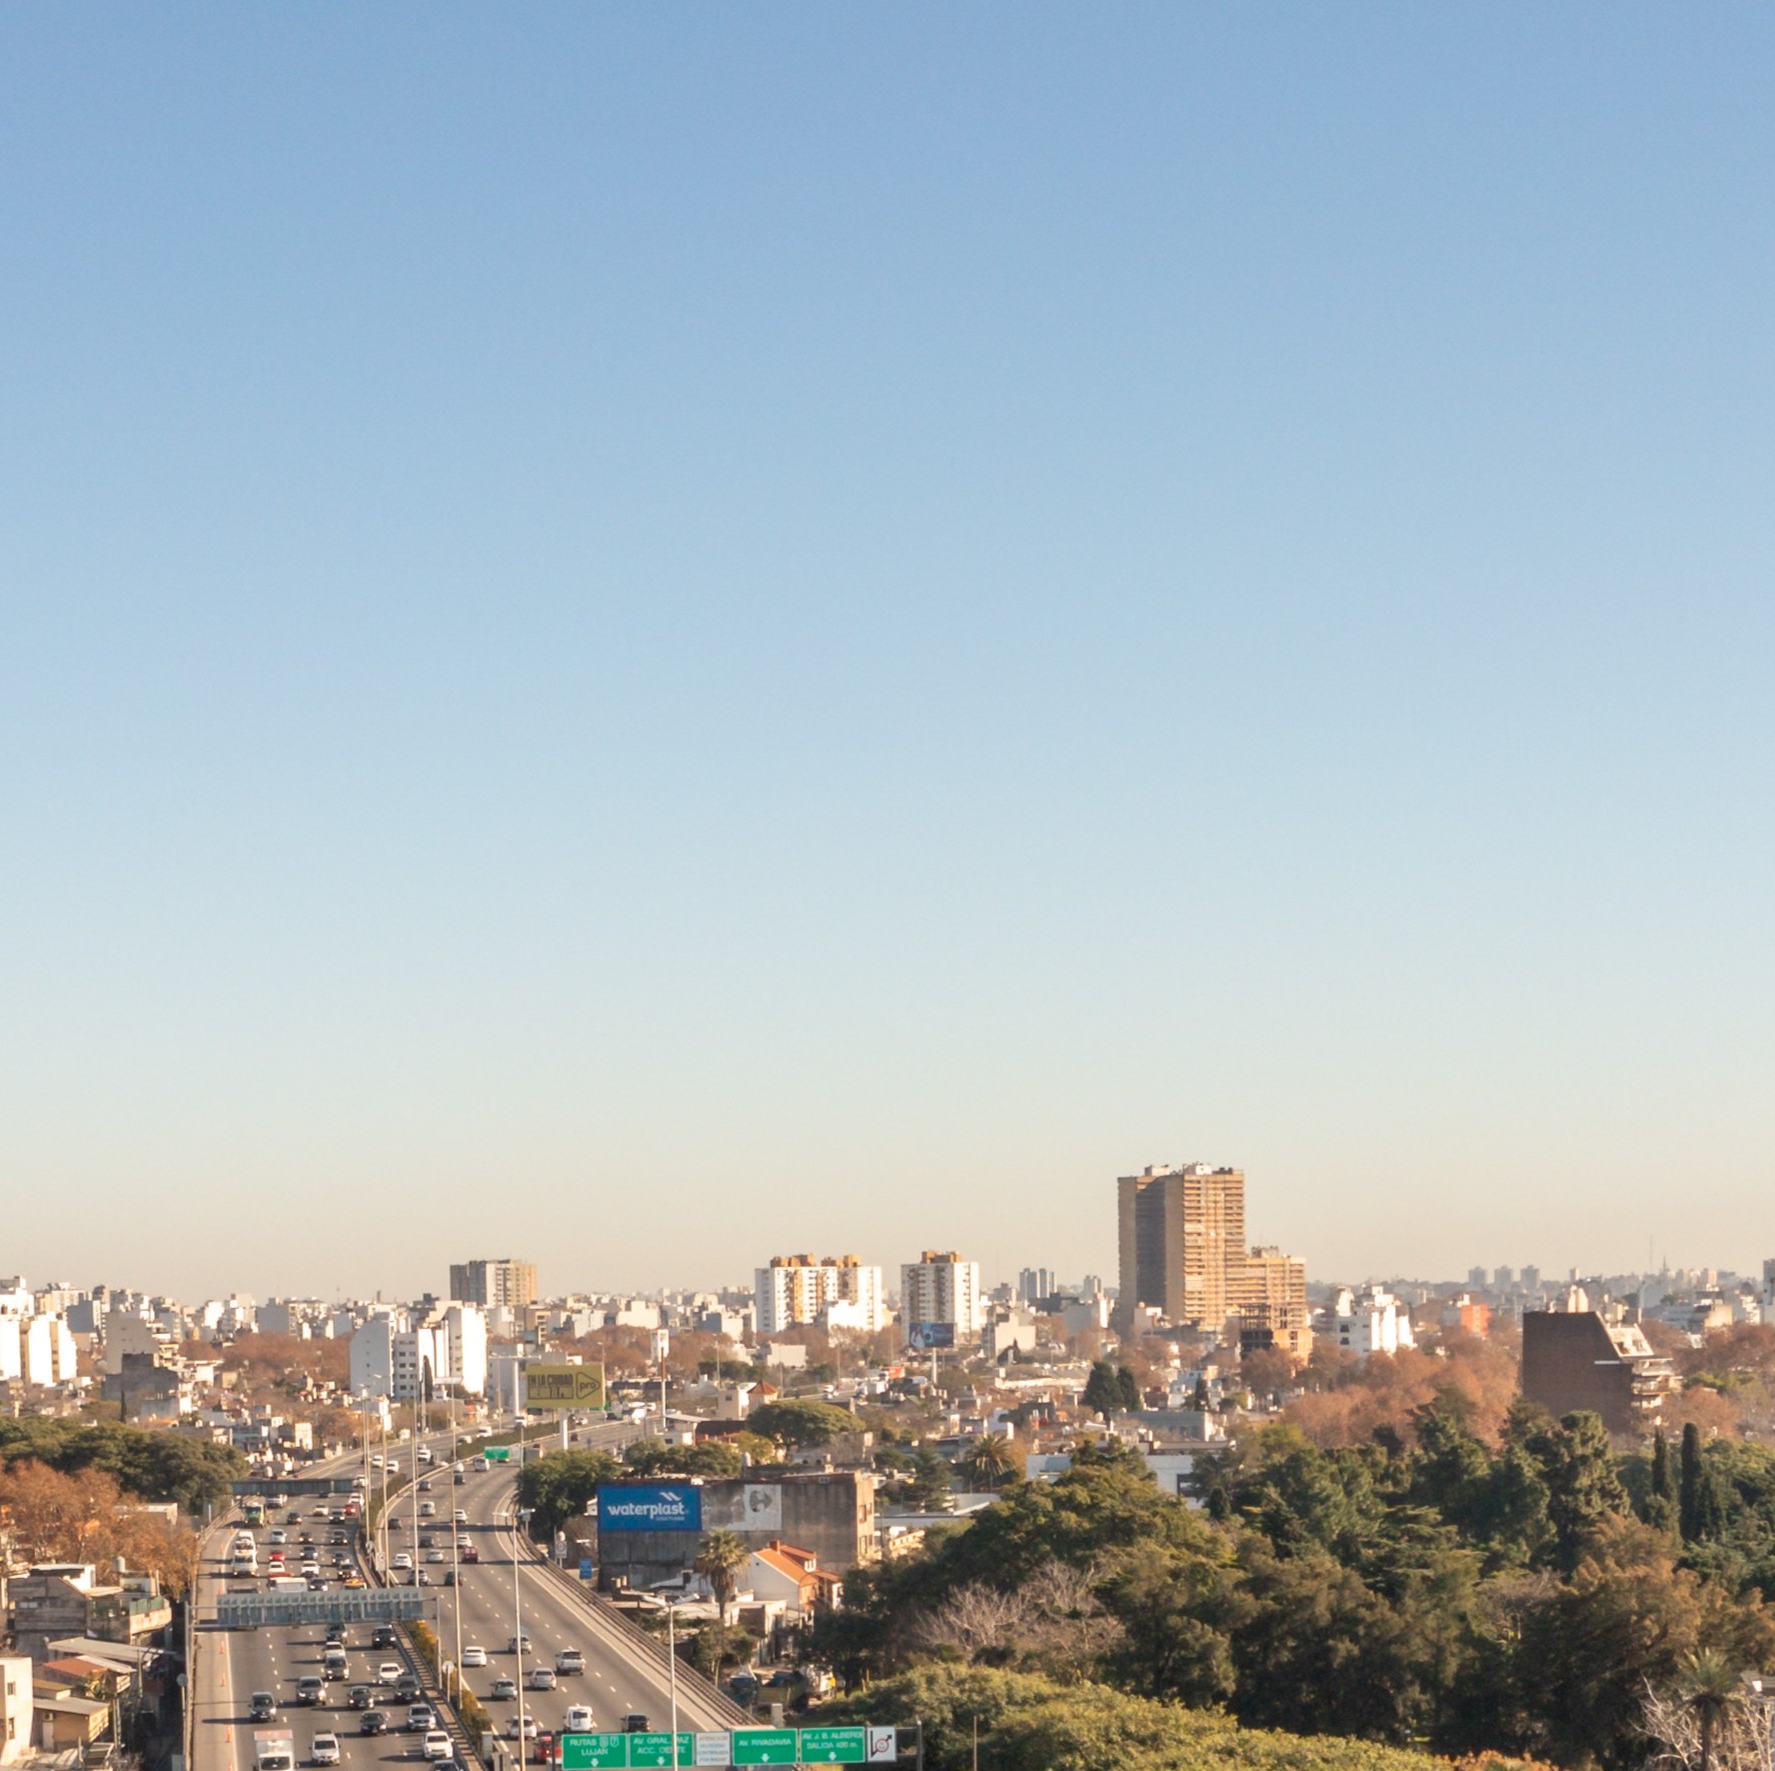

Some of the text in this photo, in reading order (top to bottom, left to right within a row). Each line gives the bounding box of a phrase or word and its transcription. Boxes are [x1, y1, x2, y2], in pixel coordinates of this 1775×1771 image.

[580, 1382, 596, 1392] pro
[607, 1502, 685, 1520] waterplast
[751, 1738, 792, 1746] RIVADAVIA
[659, 1746, 686, 1754] OETE
